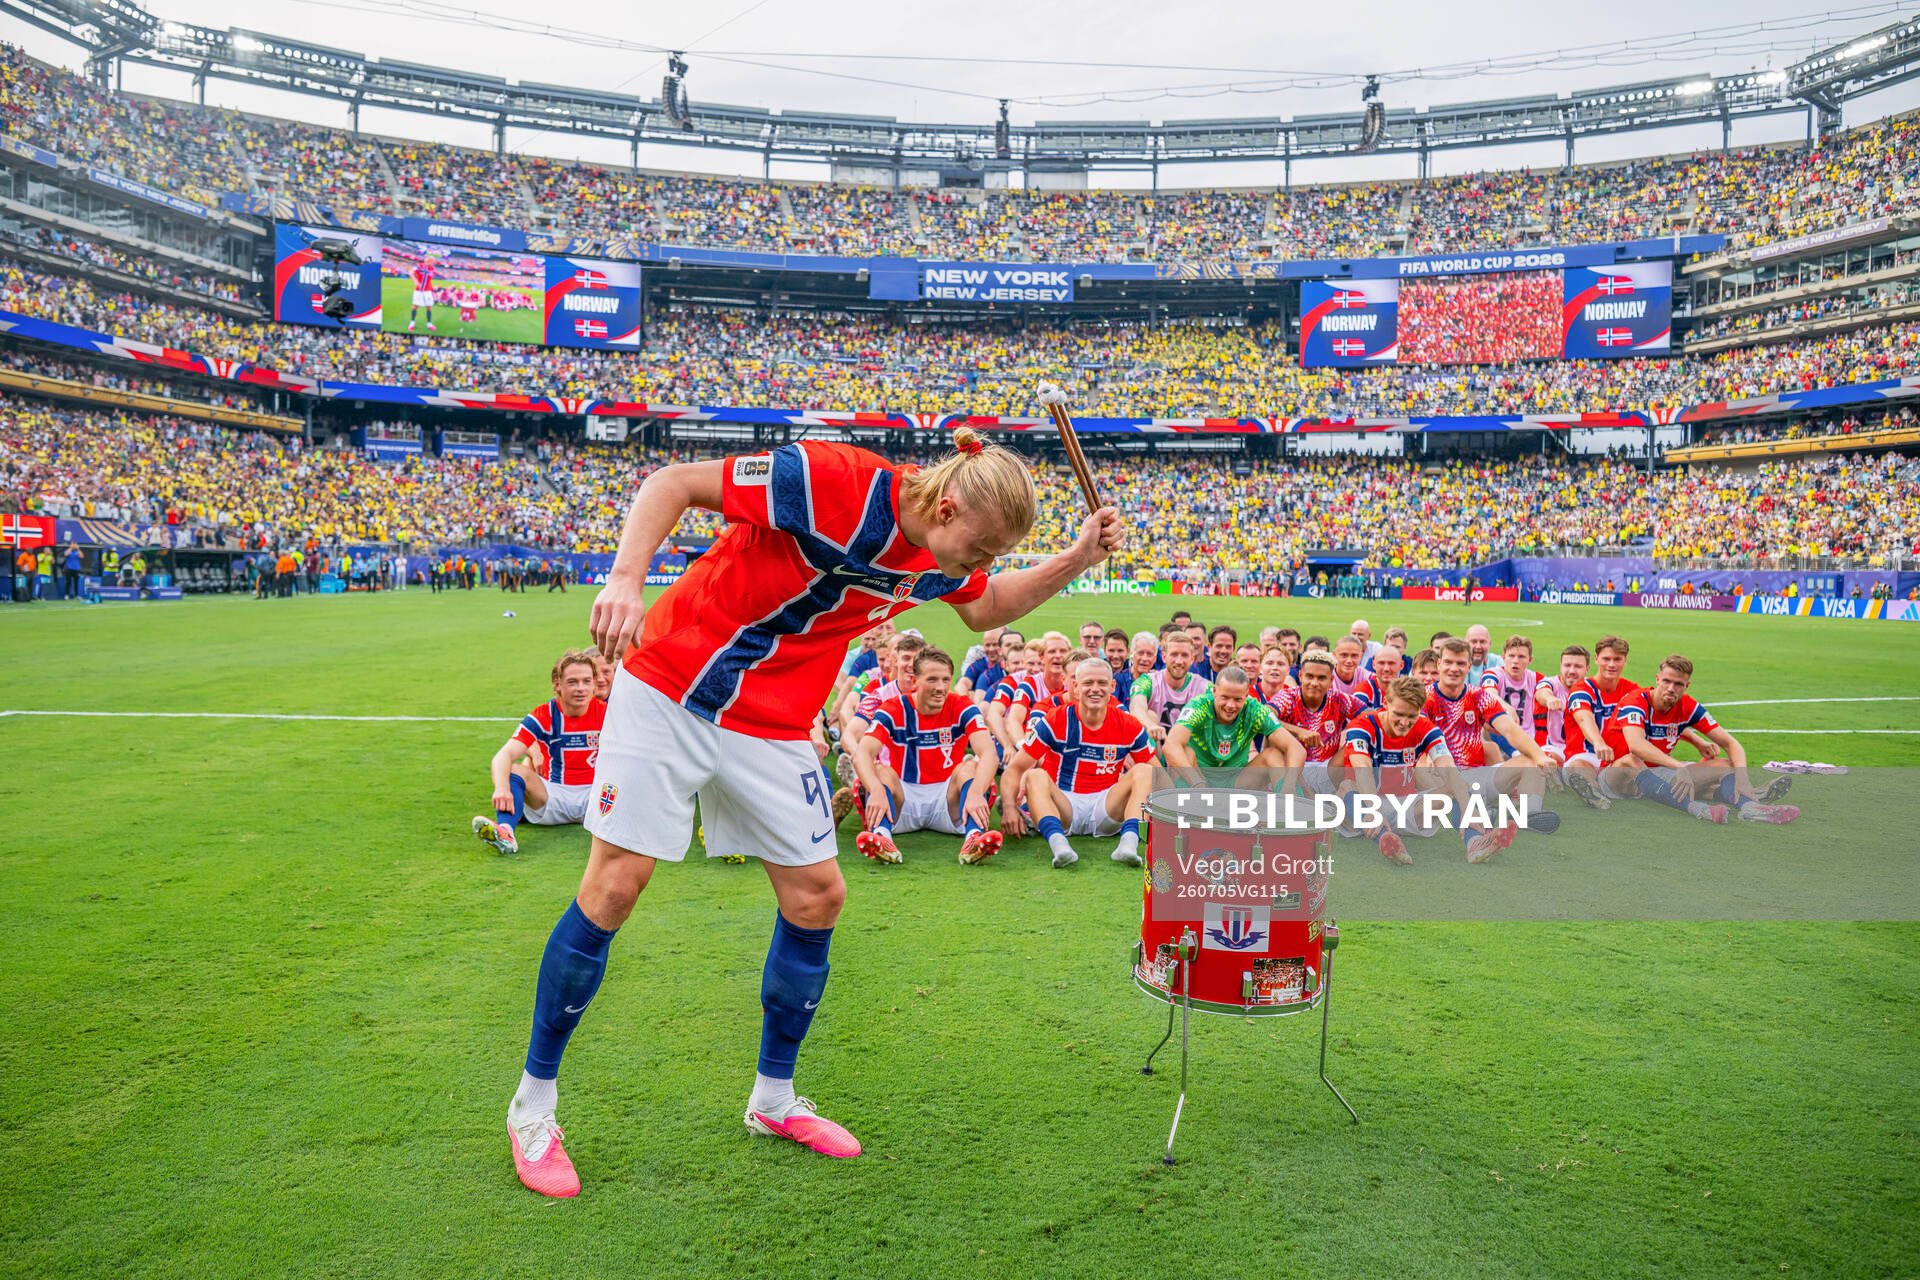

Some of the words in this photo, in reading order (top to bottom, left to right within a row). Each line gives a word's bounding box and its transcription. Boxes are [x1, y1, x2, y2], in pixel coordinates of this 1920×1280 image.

[1757, 246, 1779, 257] NEW
[1781, 240, 1808, 252] YORK
[1811, 232, 1836, 245] NEW
[1837, 222, 1880, 238] JERSEY
[1399, 262, 1429, 275] FIFA
[1432, 258, 1480, 273] WORLD
[1482, 256, 1512, 269] CUP
[1513, 253, 1566, 268] 2026
[925, 269, 988, 285] NEW
[993, 270, 1069, 286] YORK
[925, 286, 976, 300] NEW
[980, 287, 1069, 302] JERSEY
[563, 294, 620, 314] NORWAY
[1584, 300, 1647, 321] NORWAY
[1321, 314, 1378, 332] NORWAY
[1659, 579, 1677, 589] FIFA
[1641, 593, 1670, 608] QATAR
[1672, 594, 1712, 610] AIRWAYS
[1760, 597, 1791, 615] VISA
[1823, 598, 1857, 618] VISA
[800, 769, 830, 819] 9
